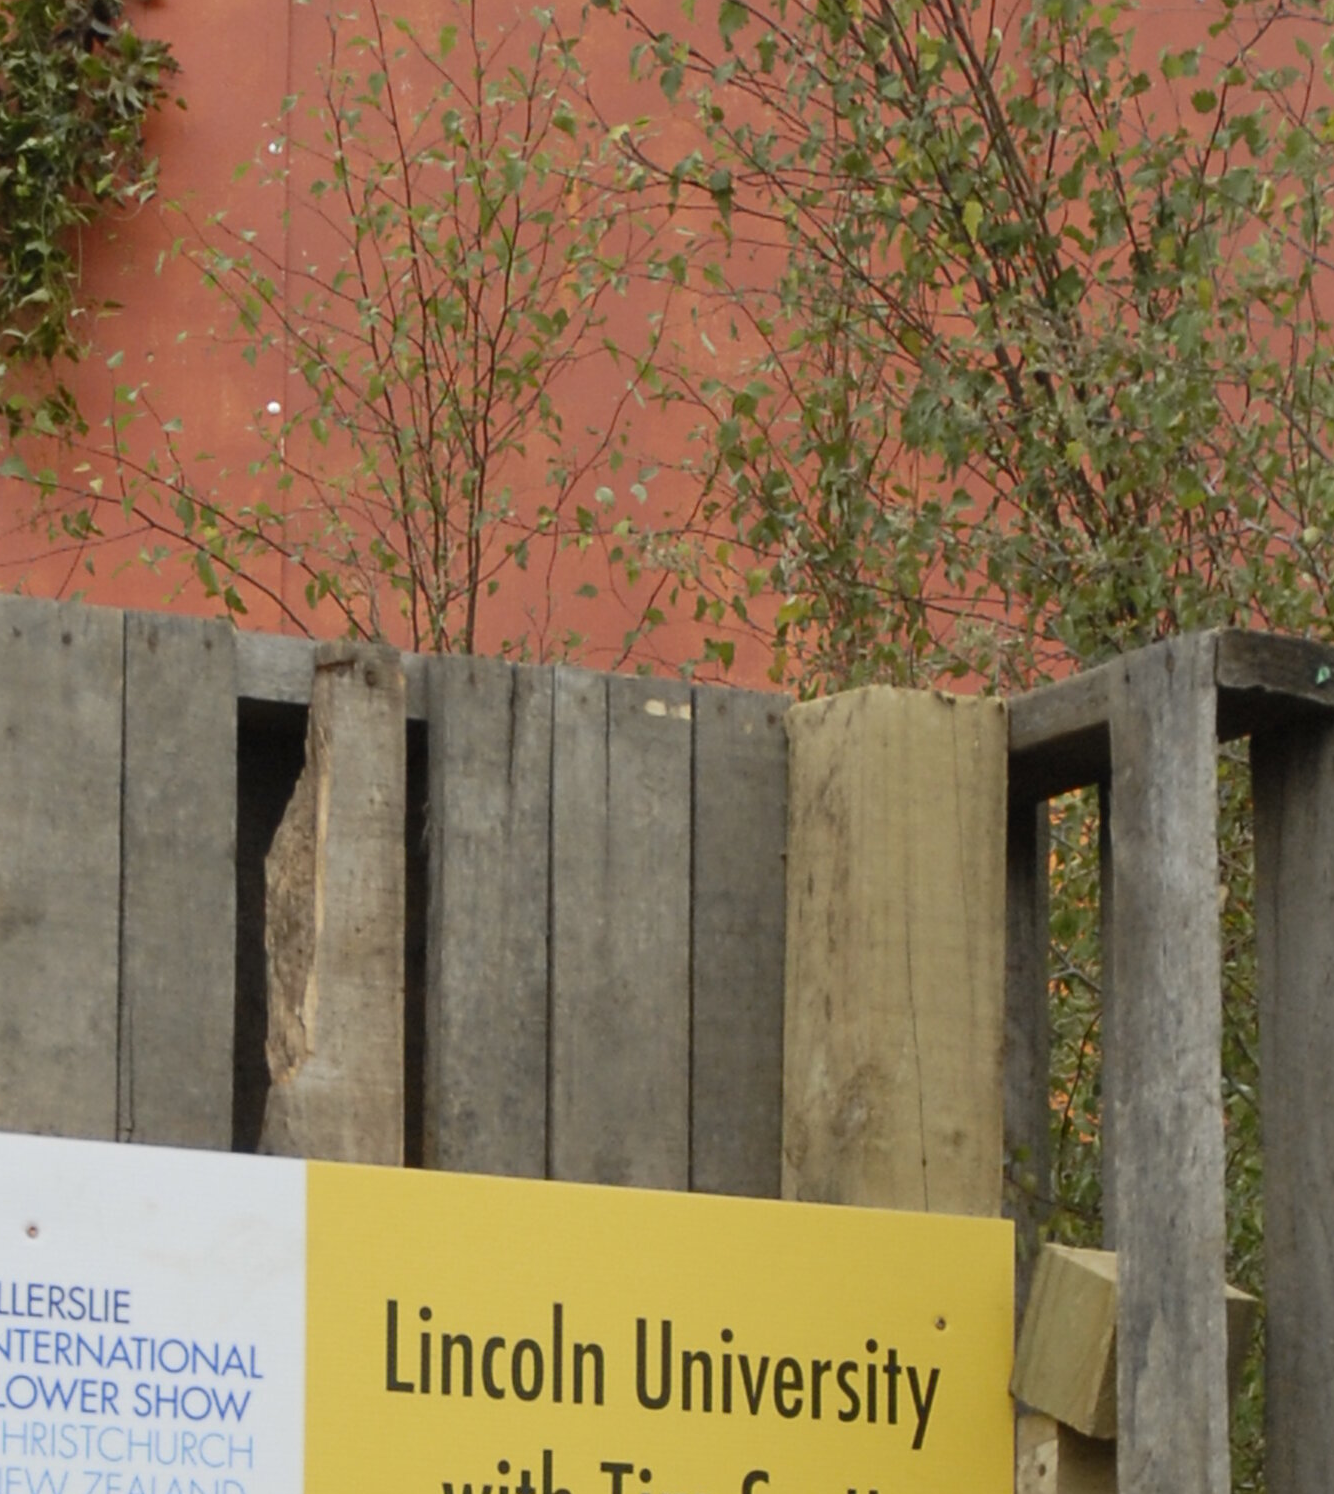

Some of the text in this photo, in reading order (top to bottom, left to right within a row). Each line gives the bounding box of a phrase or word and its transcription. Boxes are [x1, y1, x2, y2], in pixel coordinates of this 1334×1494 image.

[133, 1382, 252, 1422] SHOW
[385, 1299, 941, 1451] Lincoln University
